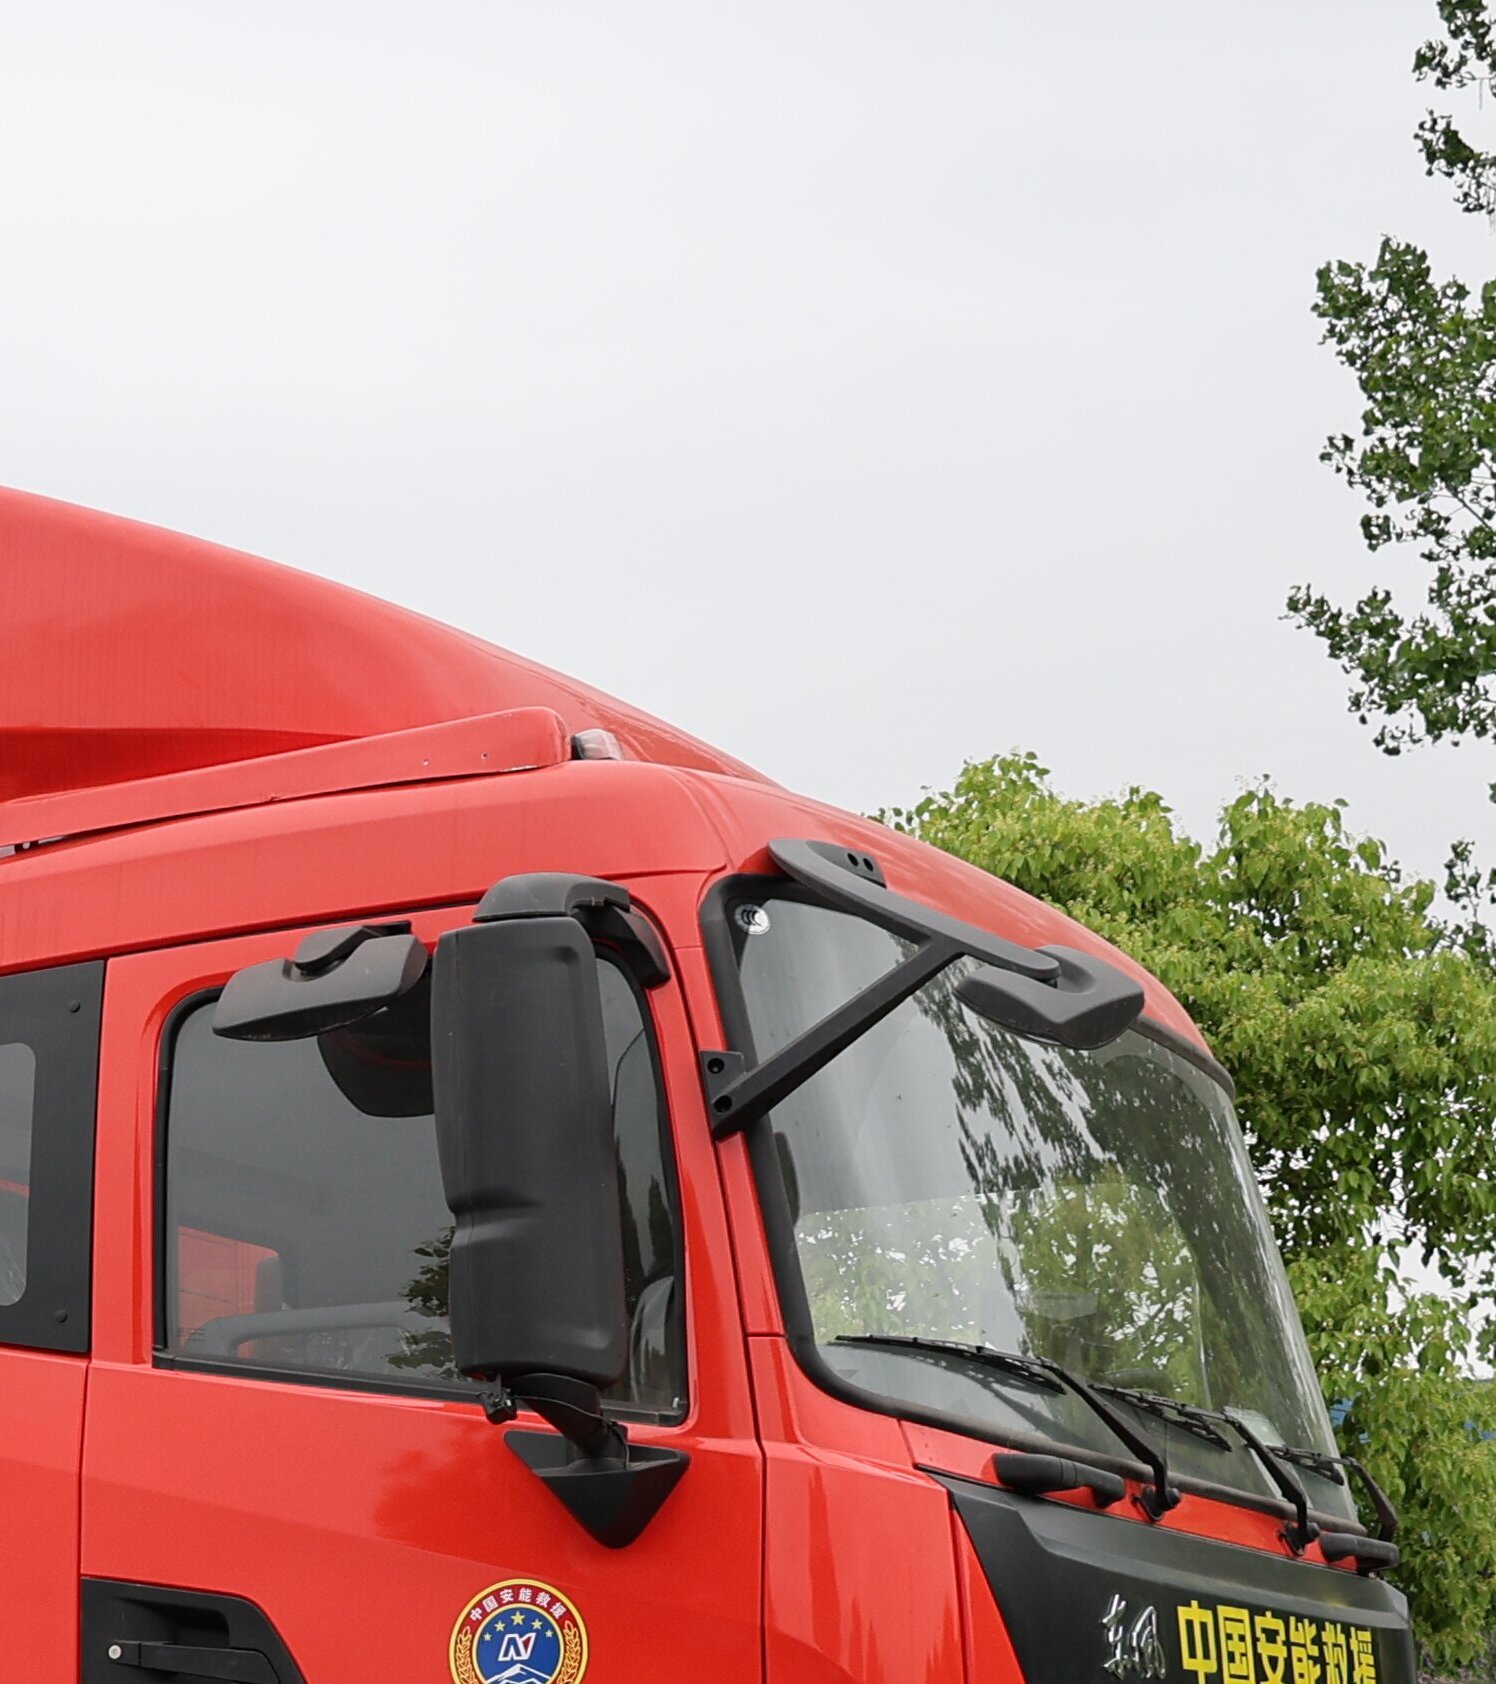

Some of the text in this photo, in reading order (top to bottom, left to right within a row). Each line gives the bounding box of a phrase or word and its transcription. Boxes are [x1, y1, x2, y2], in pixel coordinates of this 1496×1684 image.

[469, 1587, 568, 1621] 中国安能救援
